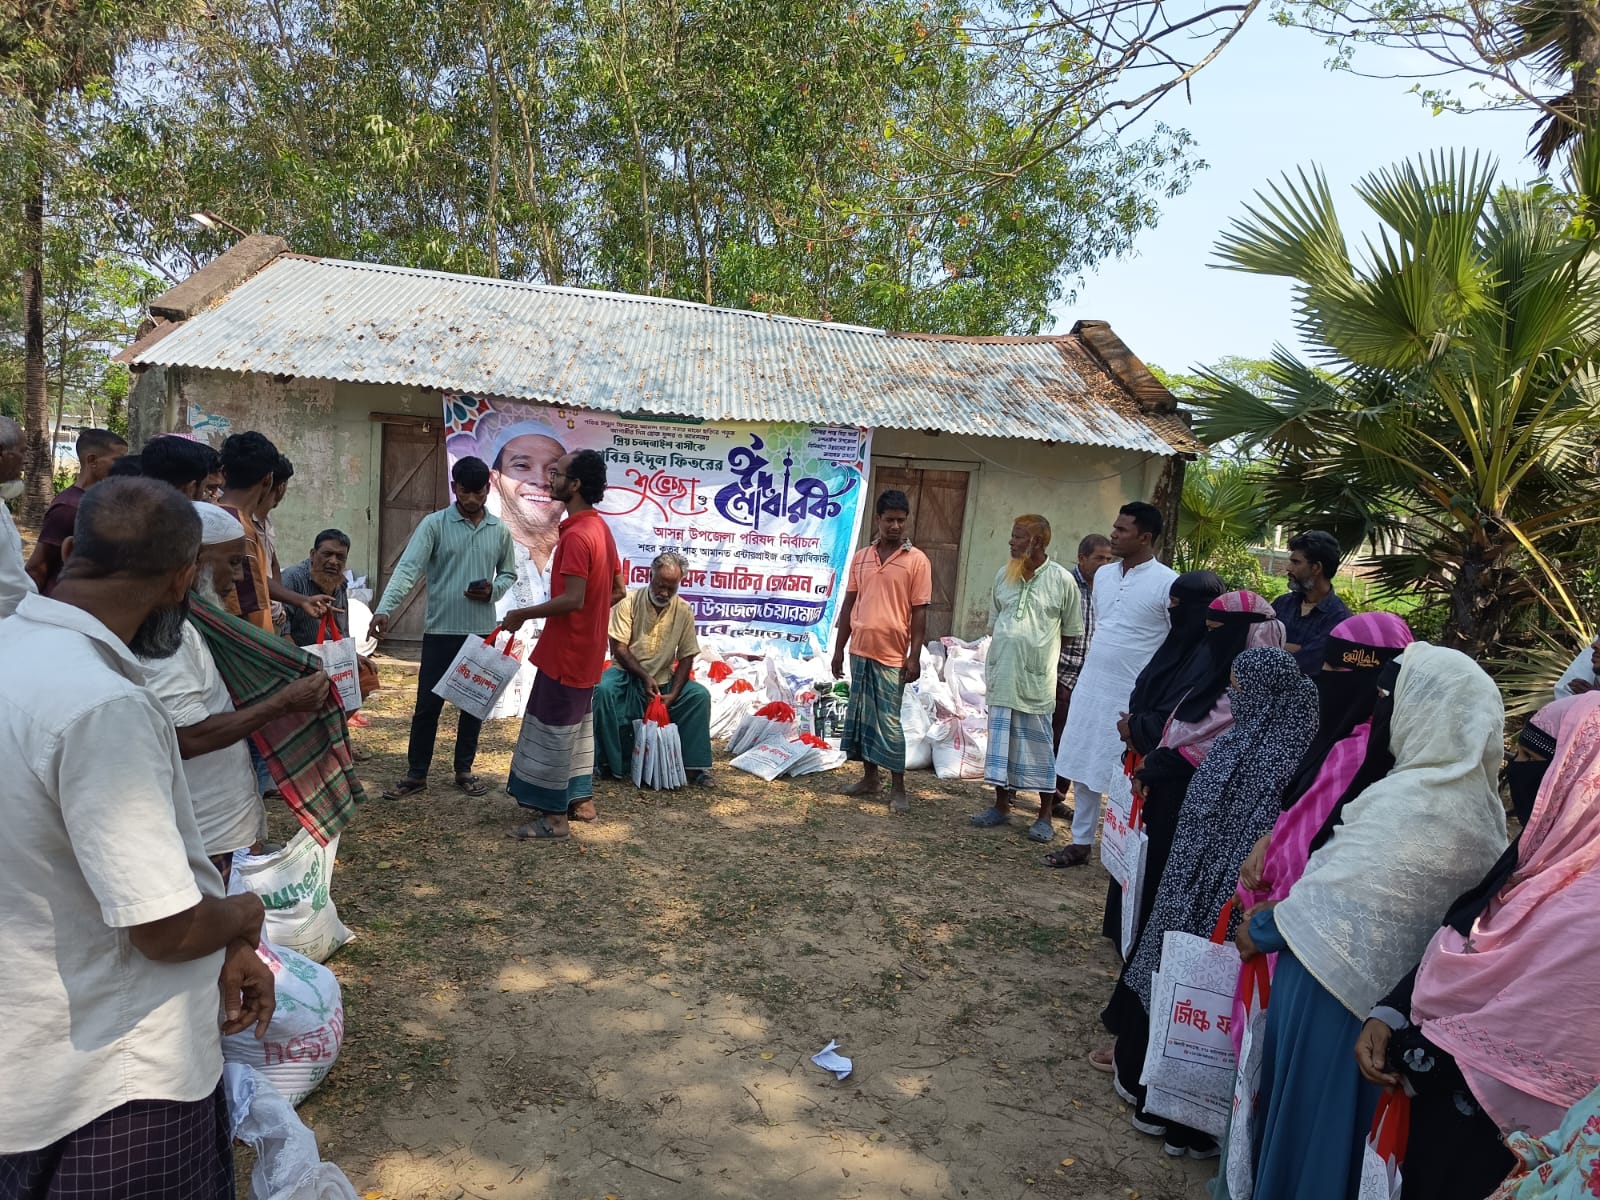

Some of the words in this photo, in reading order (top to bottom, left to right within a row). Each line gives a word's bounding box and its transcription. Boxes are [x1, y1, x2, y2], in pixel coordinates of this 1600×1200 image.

[613, 435, 630, 446] প্রিয়
[632, 437, 673, 449] চন্দনাইশ
[675, 439, 706, 452] বাসীকে
[633, 450, 667, 470] ঈদুল
[669, 452, 723, 471] ফিতরের
[653, 526, 685, 540] আসন্ন
[688, 527, 735, 543] উপজেলা
[739, 530, 776, 549] পরিষদ
[779, 532, 820, 549] নির্বাচনে
[699, 548, 731, 558] আমানত
[780, 553, 792, 562] এর
[710, 566, 763, 594] জাকির
[766, 573, 813, 593] হোসেন
[701, 598, 762, 618] উপজেলা
[260, 850, 320, 910] Wheel
